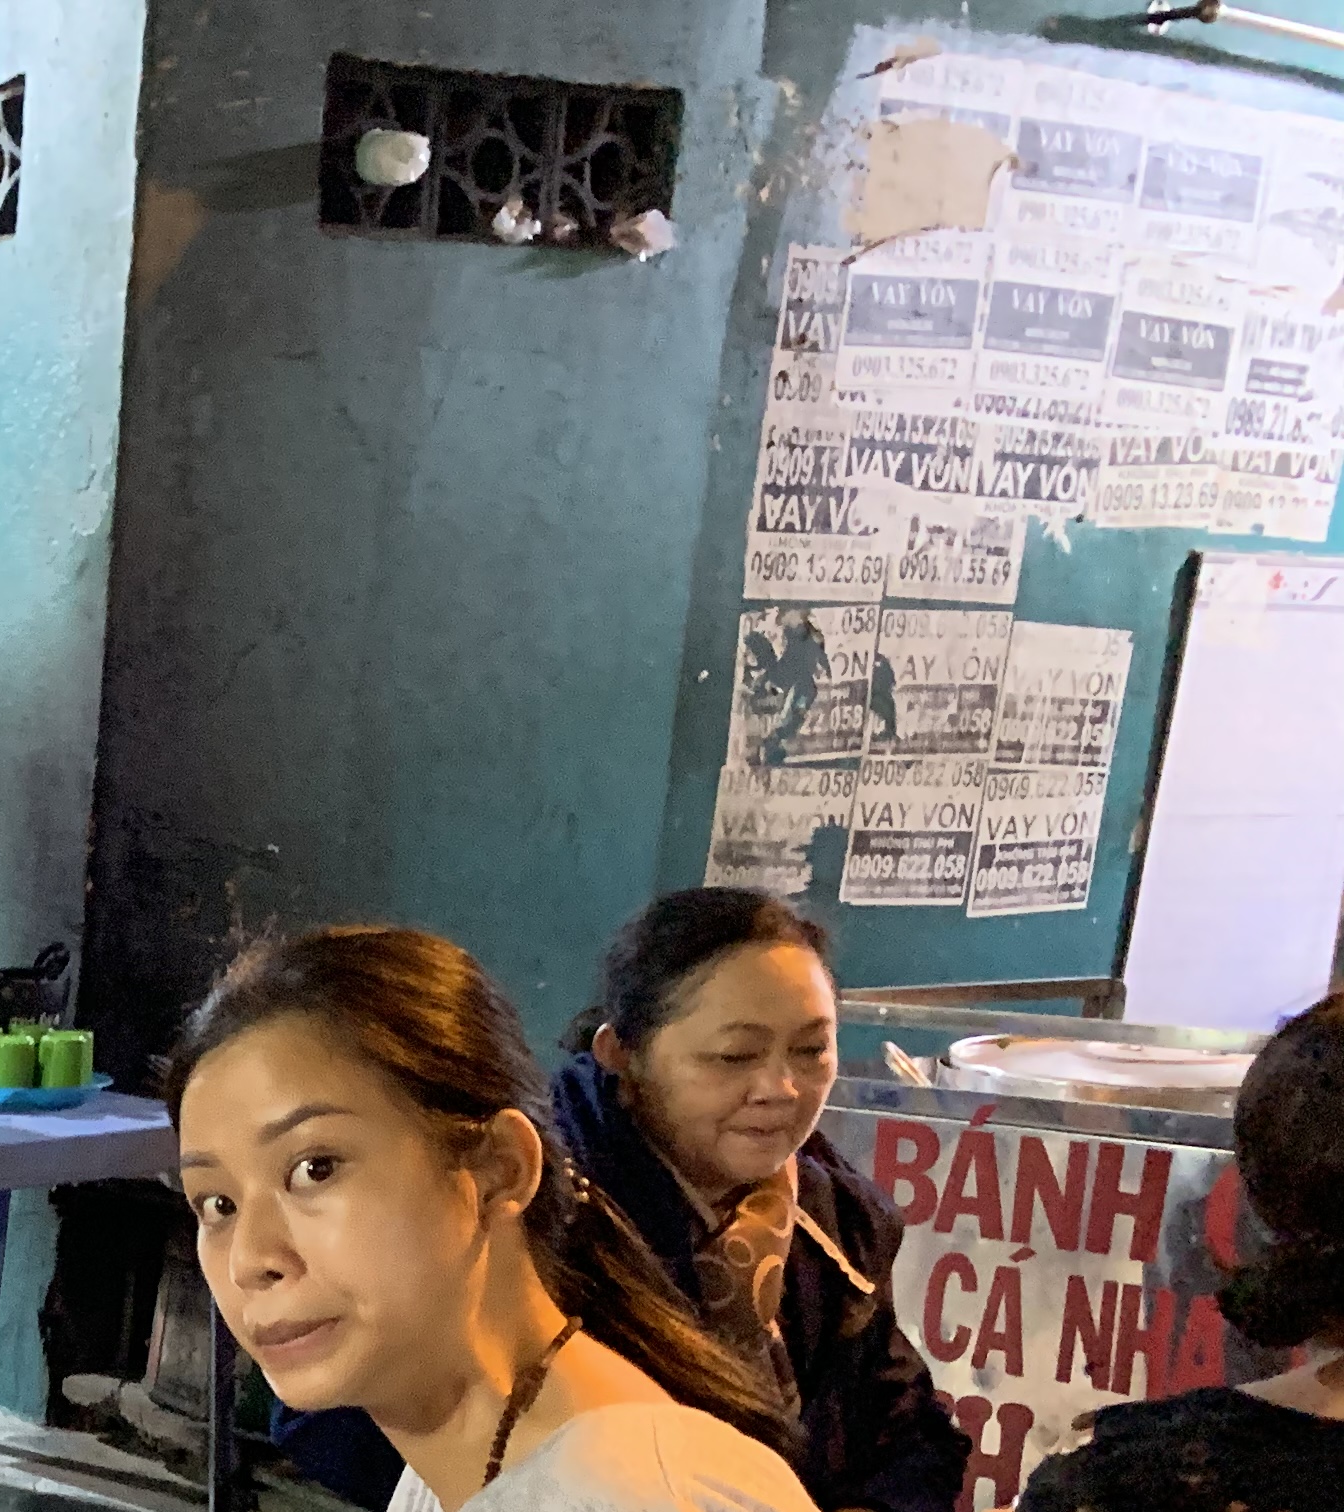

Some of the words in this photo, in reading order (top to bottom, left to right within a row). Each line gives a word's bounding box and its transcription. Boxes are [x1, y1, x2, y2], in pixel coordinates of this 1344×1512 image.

[762, 493, 822, 531] VAY
[860, 802, 913, 829] VAY
[987, 814, 1038, 841] VAY
[873, 1104, 1173, 1263] BÁNH
[923, 1246, 1036, 1378] CÁ
